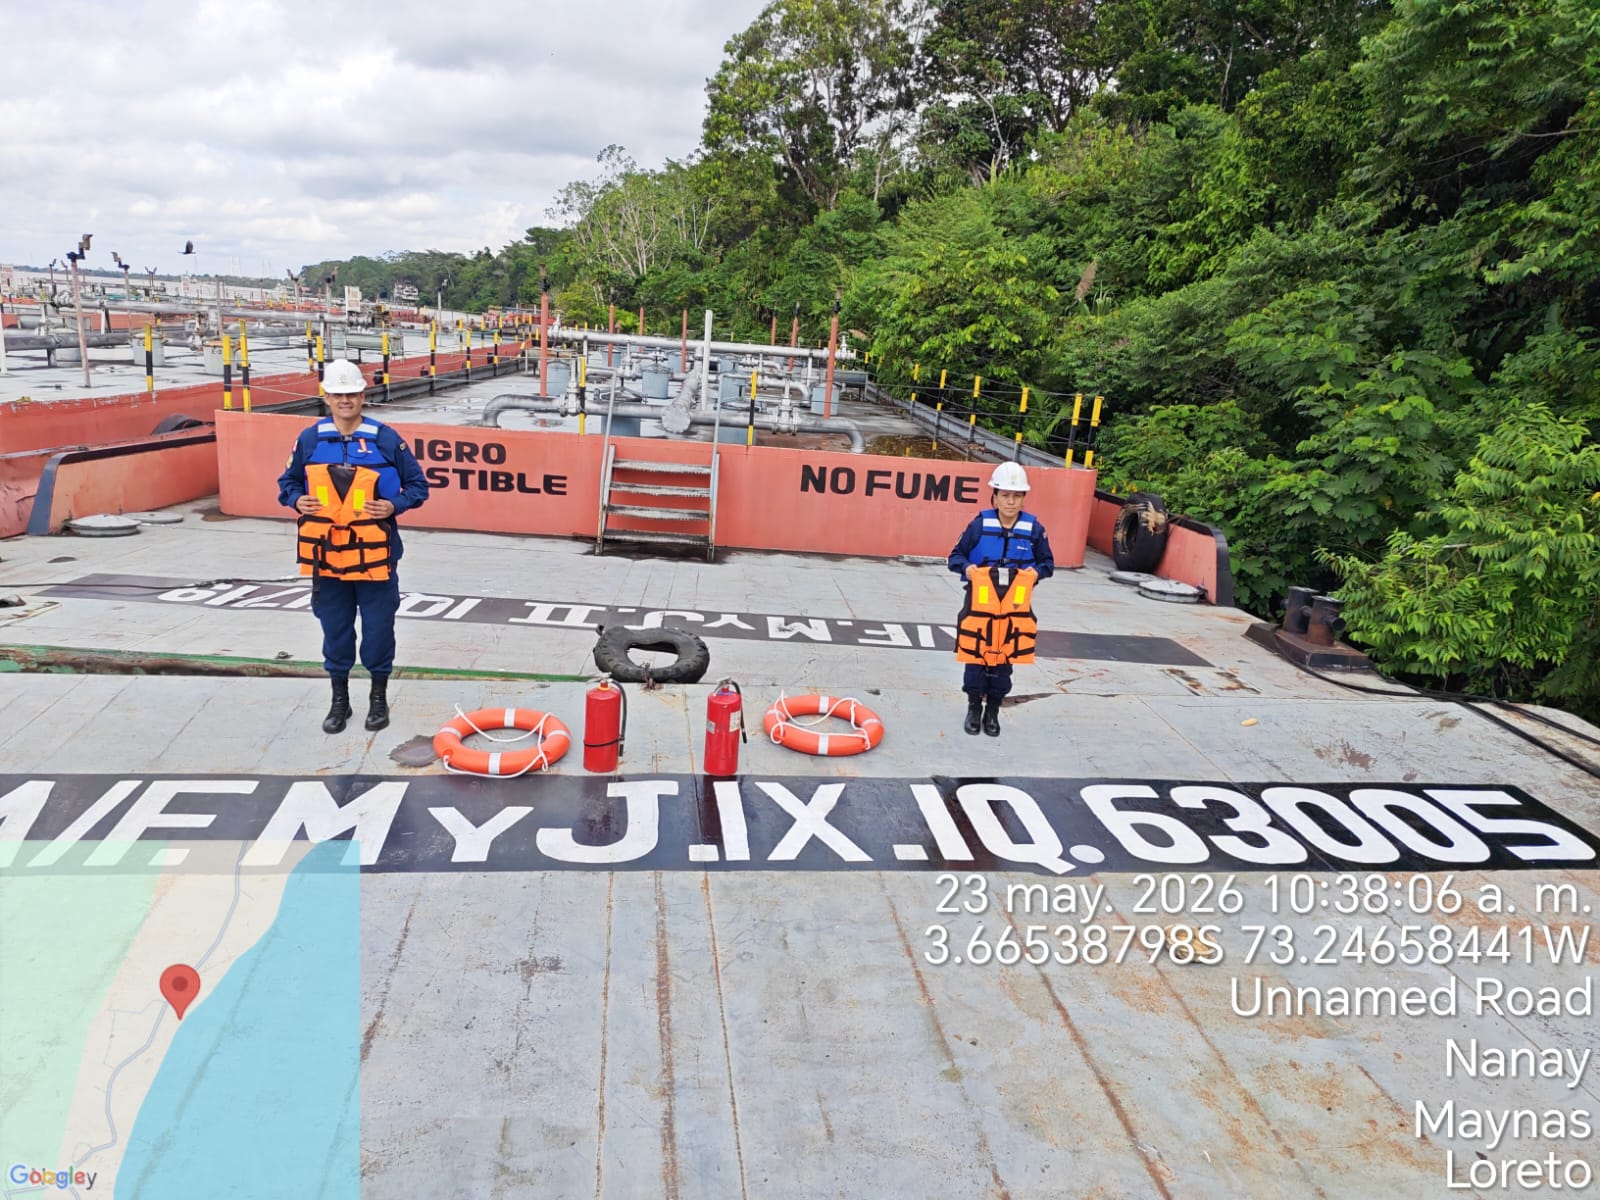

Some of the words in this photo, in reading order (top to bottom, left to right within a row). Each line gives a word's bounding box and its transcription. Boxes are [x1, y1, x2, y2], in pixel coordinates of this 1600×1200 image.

[414, 438, 507, 465] IGRO
[426, 467, 568, 496] STIBLE
[800, 464, 856, 495] NO
[865, 469, 980, 504] FUME
